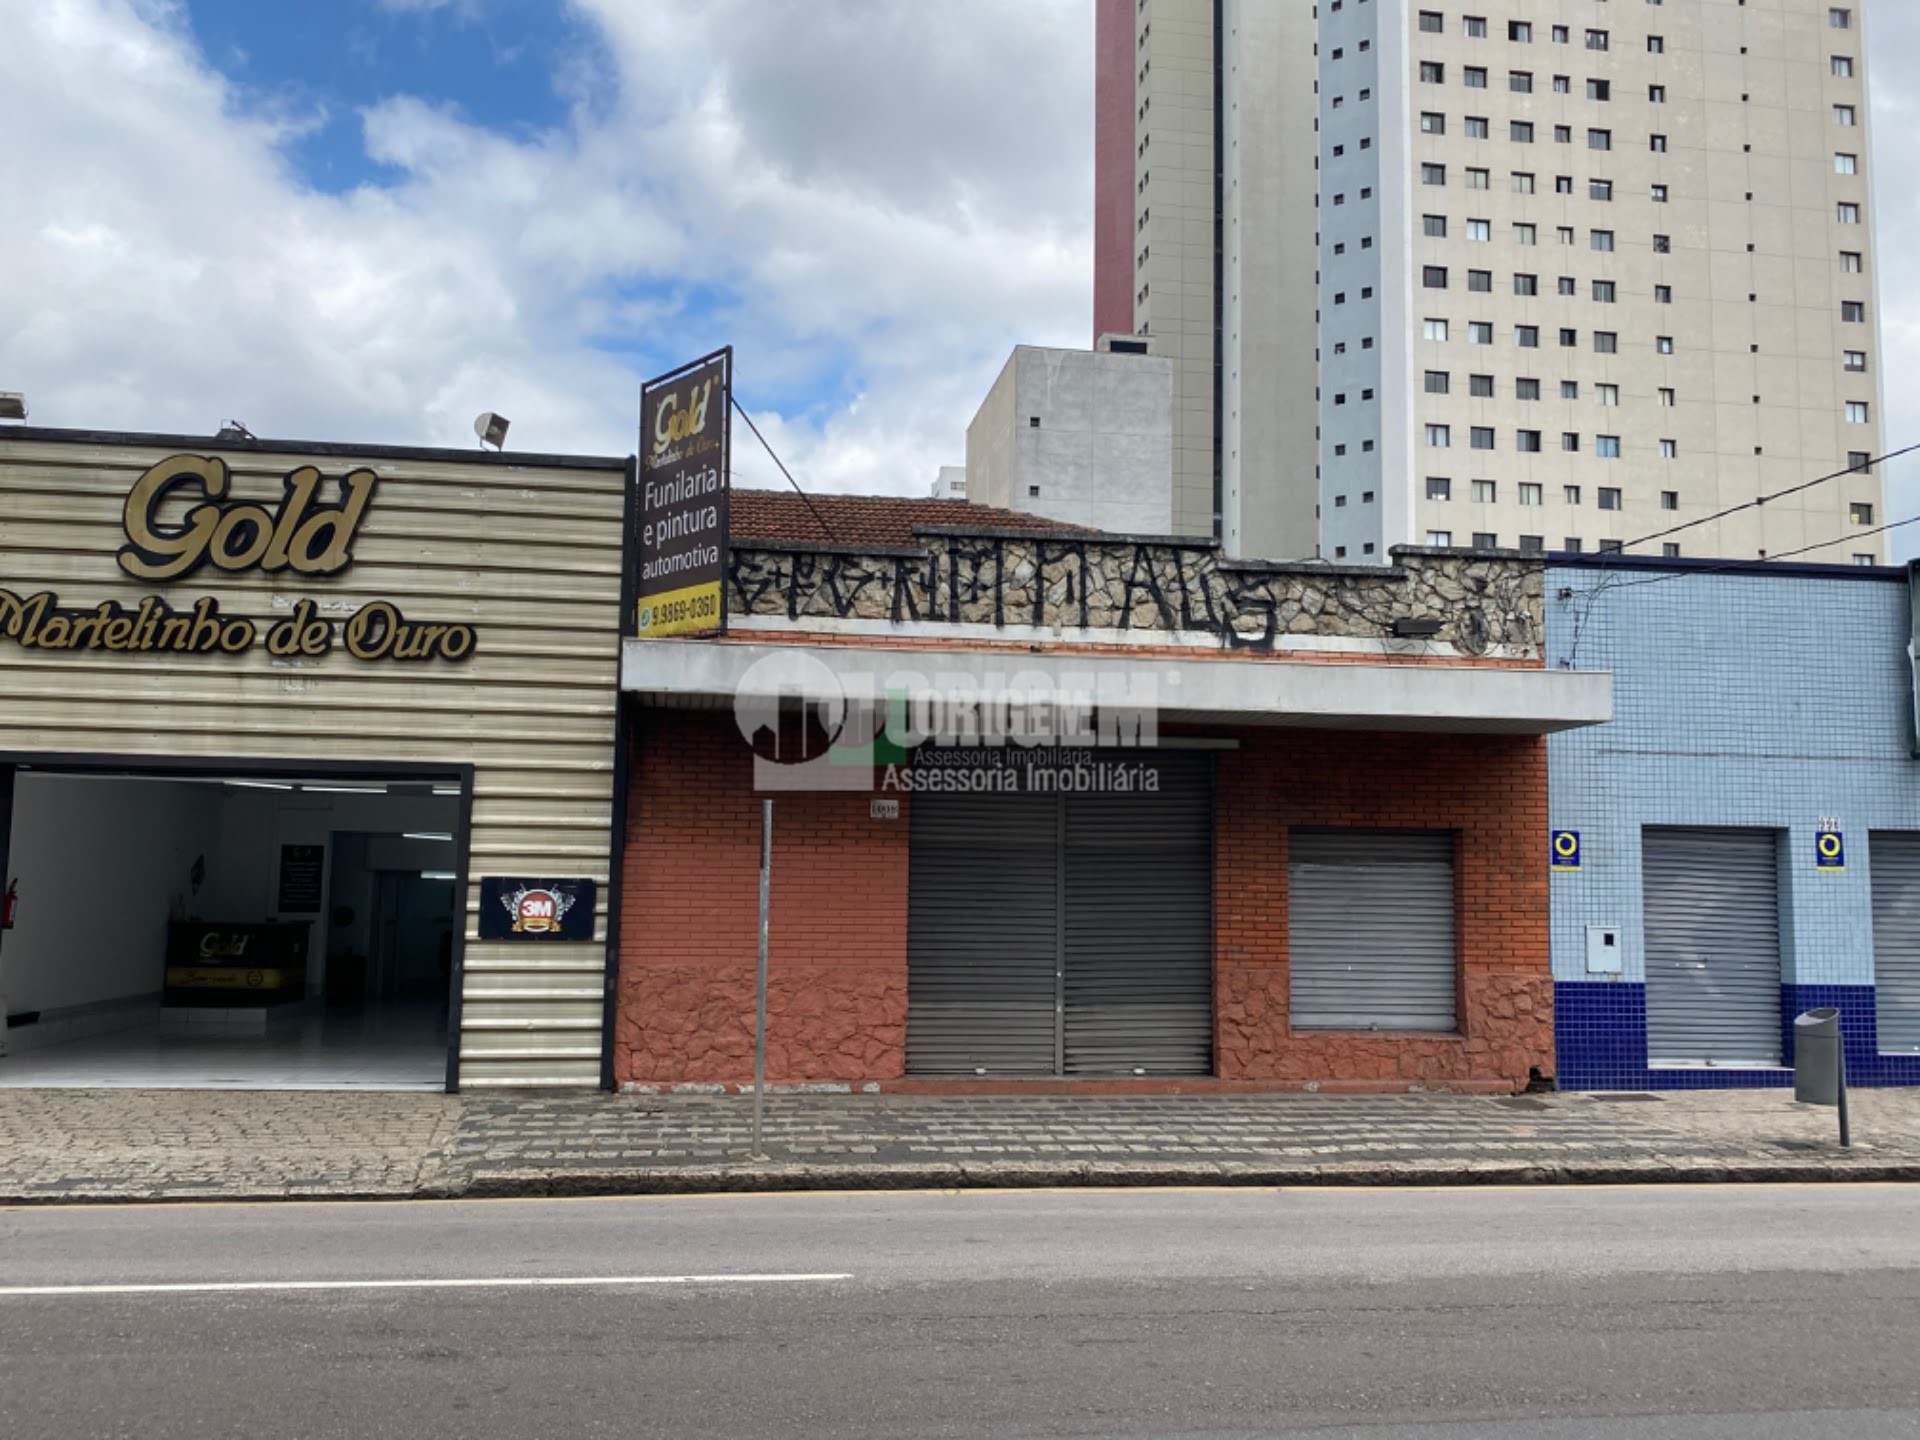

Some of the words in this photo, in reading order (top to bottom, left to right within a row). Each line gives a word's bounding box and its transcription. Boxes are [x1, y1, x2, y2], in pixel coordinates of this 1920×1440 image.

[653, 378, 711, 455] Gold
[645, 463, 718, 512] Funilaria
[118, 453, 378, 581] Gold
[643, 524, 654, 546] e
[656, 505, 718, 550] pintura
[642, 542, 719, 580] automotiva
[0, 588, 256, 652] Martelinho
[266, 600, 333, 656] de
[344, 601, 476, 661] Ouro
[521, 900, 552, 917] 3M
